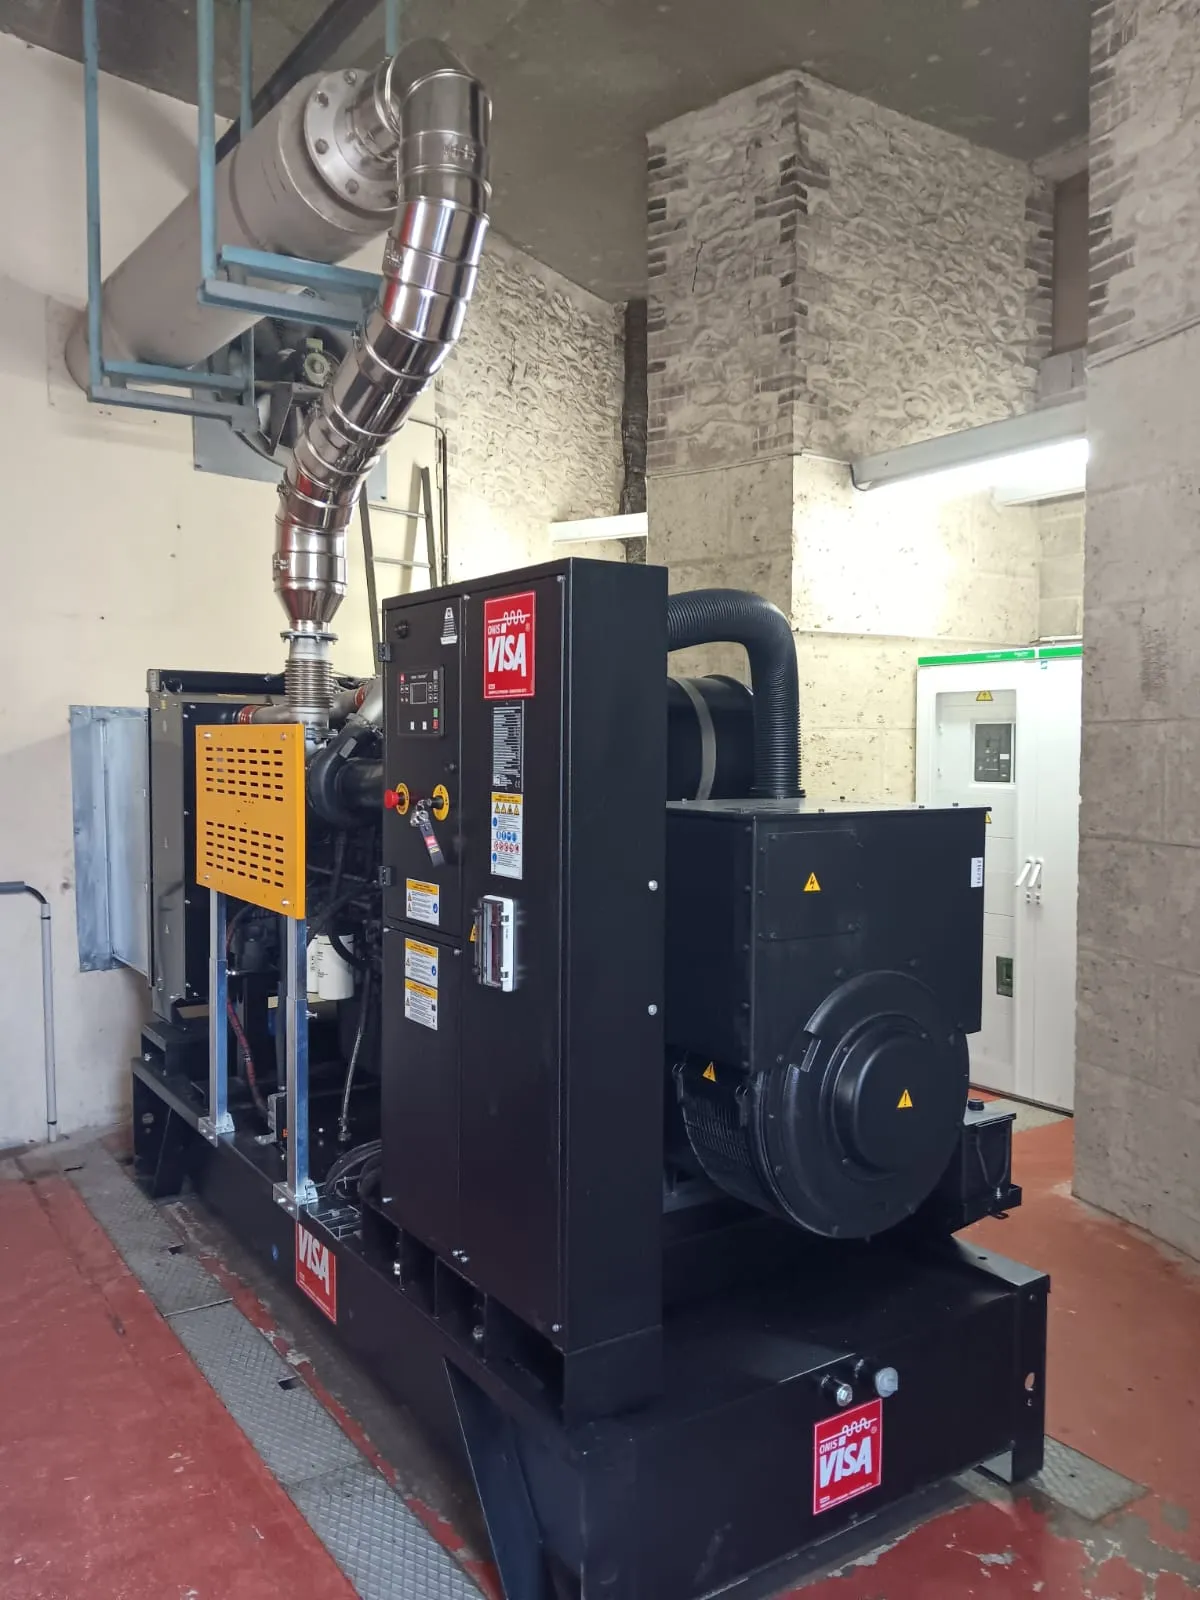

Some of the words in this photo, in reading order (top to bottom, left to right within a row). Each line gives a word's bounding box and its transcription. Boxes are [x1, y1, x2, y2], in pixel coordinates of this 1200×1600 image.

[488, 624, 501, 635] ONIS
[488, 632, 526, 677] VISA
[298, 1223, 330, 1296] VISA
[820, 1439, 838, 1454] ONIS
[820, 1436, 872, 1489] VISA
